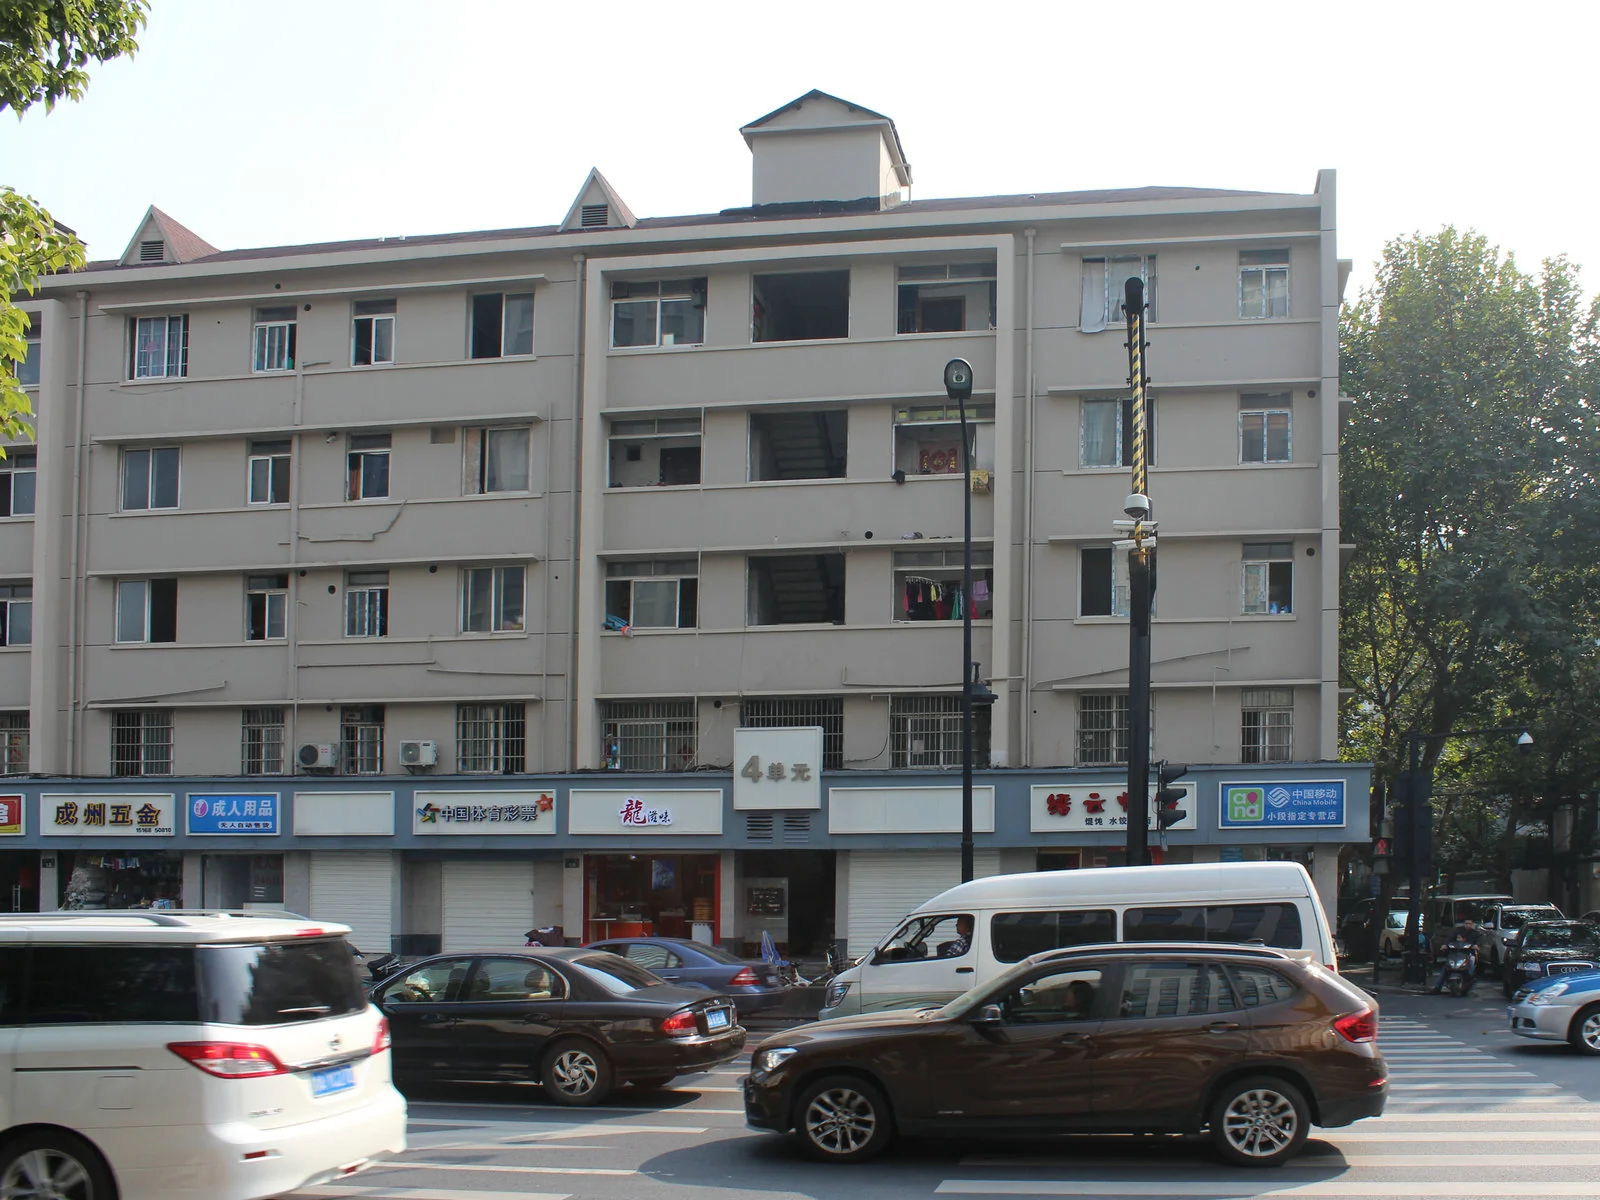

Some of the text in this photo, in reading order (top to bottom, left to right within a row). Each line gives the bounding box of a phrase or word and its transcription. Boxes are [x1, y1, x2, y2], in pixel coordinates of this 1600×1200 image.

[741, 755, 811, 783] 4单元
[1292, 789, 1337, 799] 中国移动
[54, 801, 161, 826] 成州五金
[211, 799, 273, 817] 成人用品
[440, 805, 537, 822] 中国体育彩票
[620, 799, 671, 824] 龍滋味
[1084, 816, 1104, 825] 馄饨
